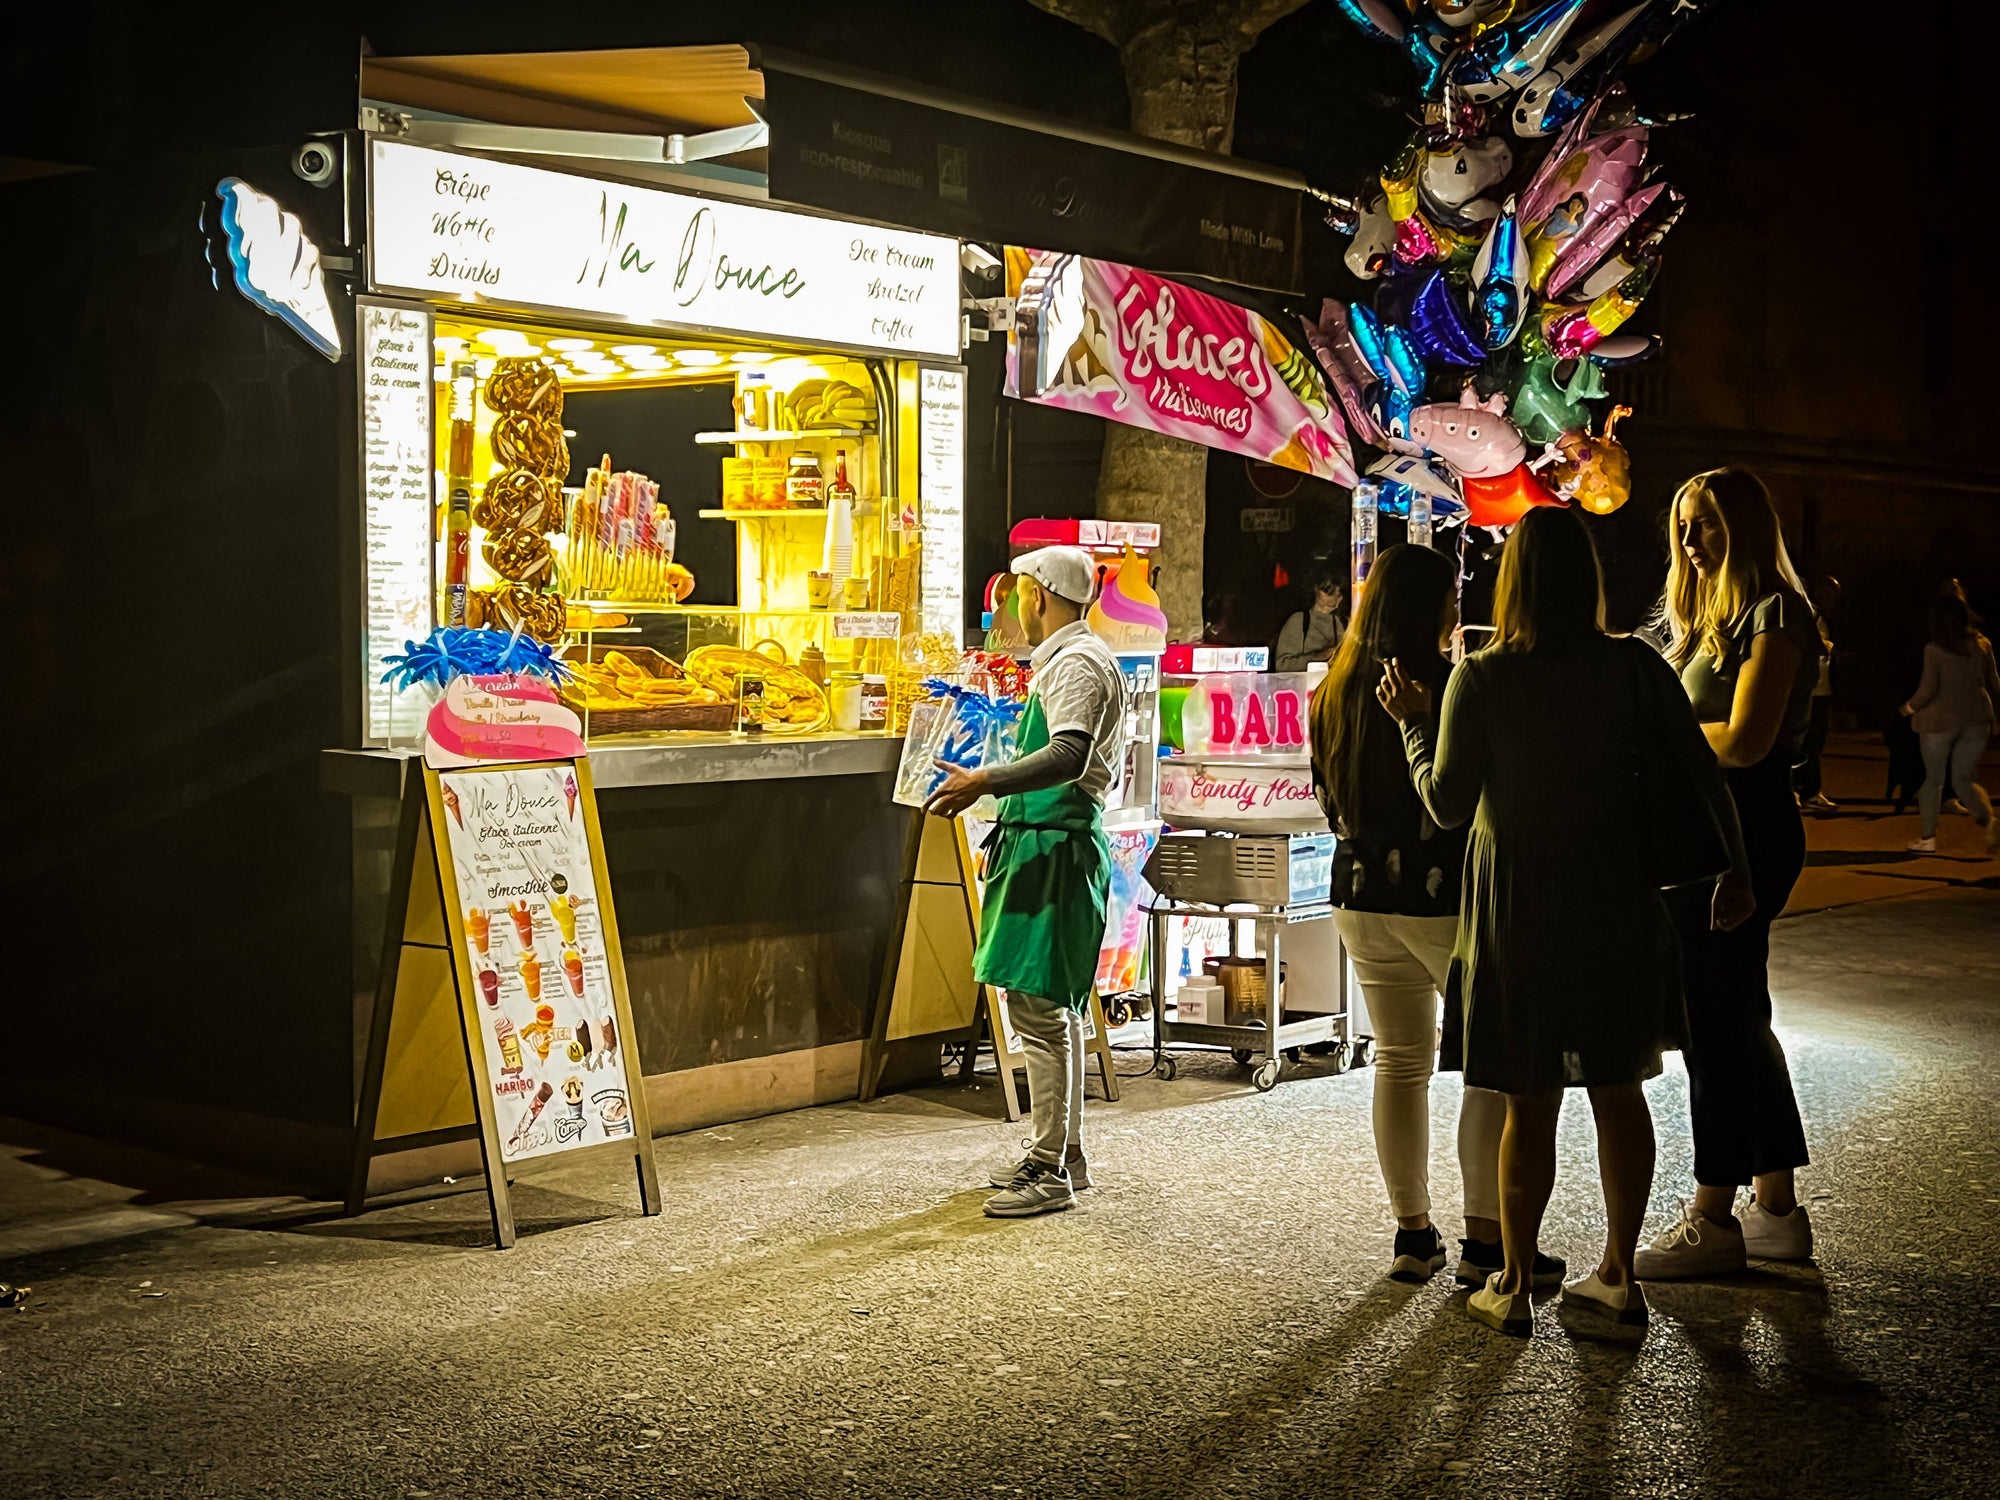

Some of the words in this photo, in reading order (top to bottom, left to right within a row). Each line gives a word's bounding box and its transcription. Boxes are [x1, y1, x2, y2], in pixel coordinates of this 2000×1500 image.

[1200, 218, 1230, 240] Made
[1230, 225, 1256, 246] With
[1258, 230, 1285, 252] Love
[577, 190, 655, 289] Ma
[673, 206, 806, 308] Douce
[849, 239, 878, 264] Ice
[428, 252, 500, 285] Drinks
[369, 373, 388, 388] Ice
[469, 785, 499, 818] Ma
[1190, 776, 1260, 812] Candy
[479, 826, 509, 843] Glace
[513, 822, 559, 836] italienne
[517, 840, 541, 848] cream
[487, 877, 550, 898] Smoothie
[495, 1078, 534, 1095] HARIBO
